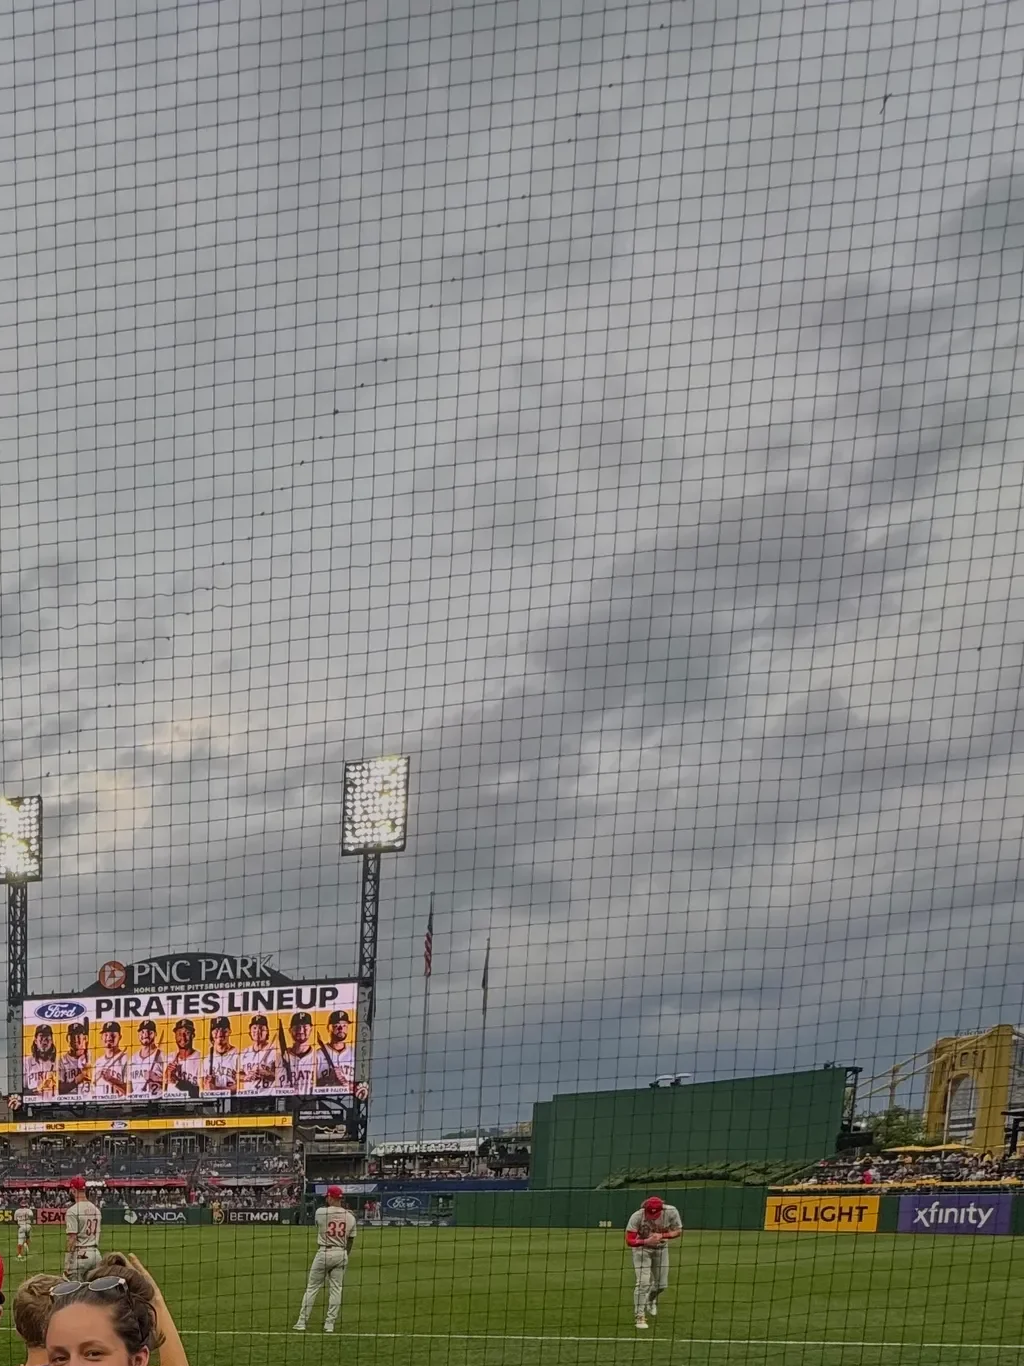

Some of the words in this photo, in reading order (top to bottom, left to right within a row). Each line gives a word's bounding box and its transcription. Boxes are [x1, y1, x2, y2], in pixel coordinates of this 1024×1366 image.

[133, 961, 191, 985] PNC
[198, 954, 273, 981] PARK
[134, 986, 157, 994] HOME
[157, 984, 166, 992] OF
[166, 984, 184, 992] THE
[187, 982, 236, 990] PITTSBURGH
[238, 980, 270, 988] PIRATES
[95, 993, 221, 1019] PIRATES
[227, 986, 339, 1013] LINEUP
[43, 1003, 77, 1019] Ford
[392, 1196, 416, 1208] Ford
[230, 1212, 278, 1222] BETMGM
[802, 1206, 868, 1222] LIGHT
[912, 1201, 994, 1228] xfinity
[85, 1218, 98, 1236] 37
[328, 1221, 346, 1238] 33
